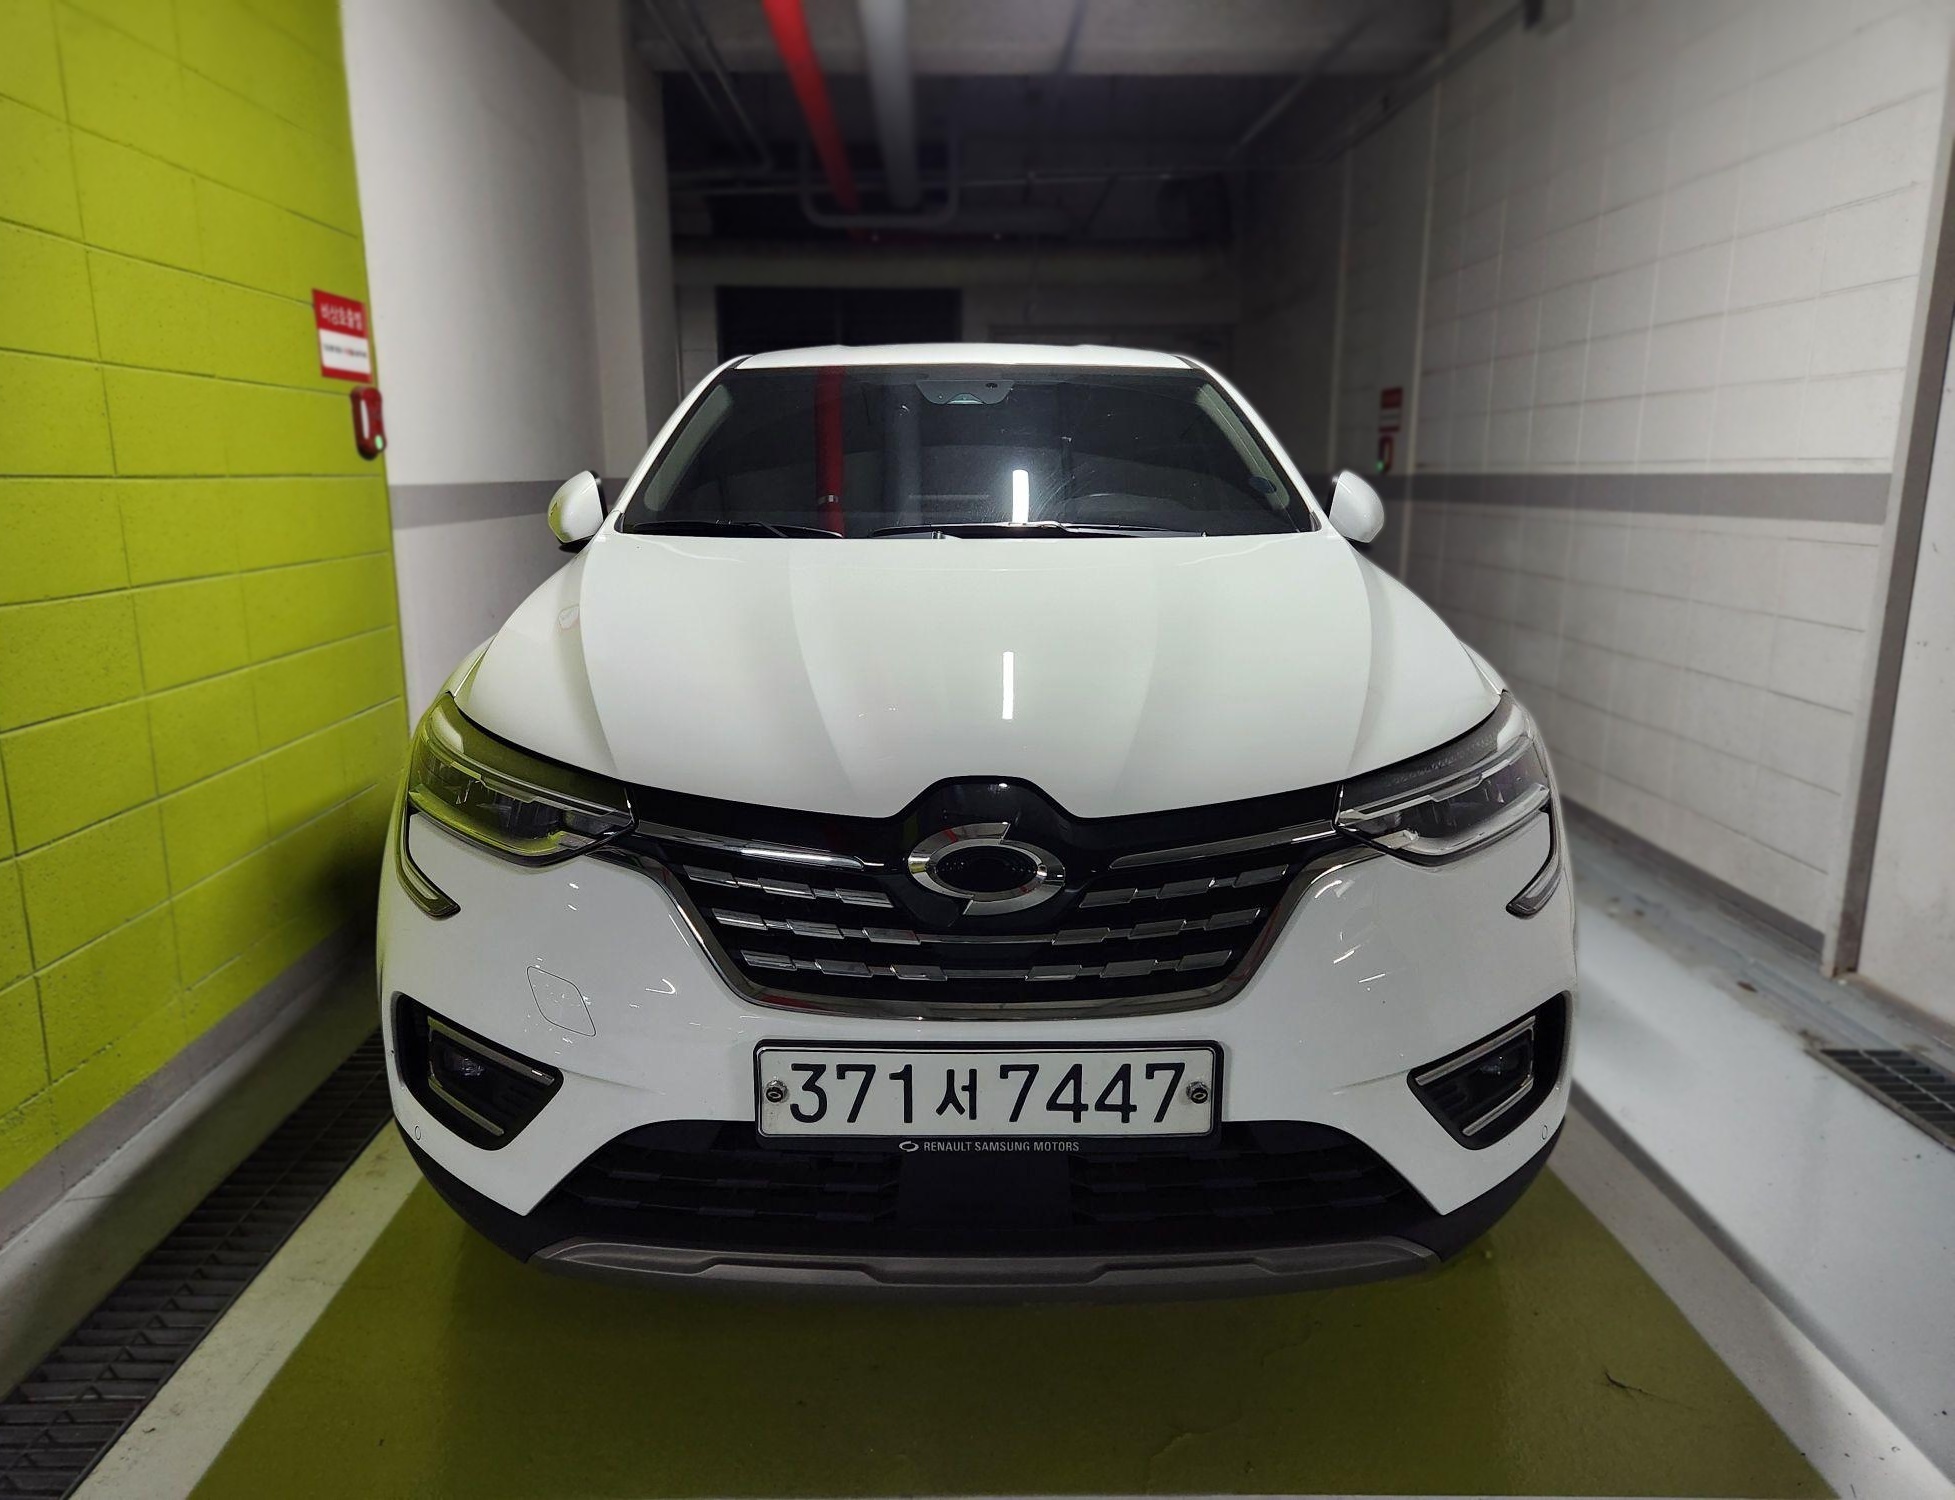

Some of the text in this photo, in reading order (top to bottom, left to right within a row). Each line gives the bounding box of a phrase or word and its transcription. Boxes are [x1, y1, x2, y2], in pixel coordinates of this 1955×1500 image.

[923, 1141, 1080, 1152] RENAULT SAMSUNG MOTORS
